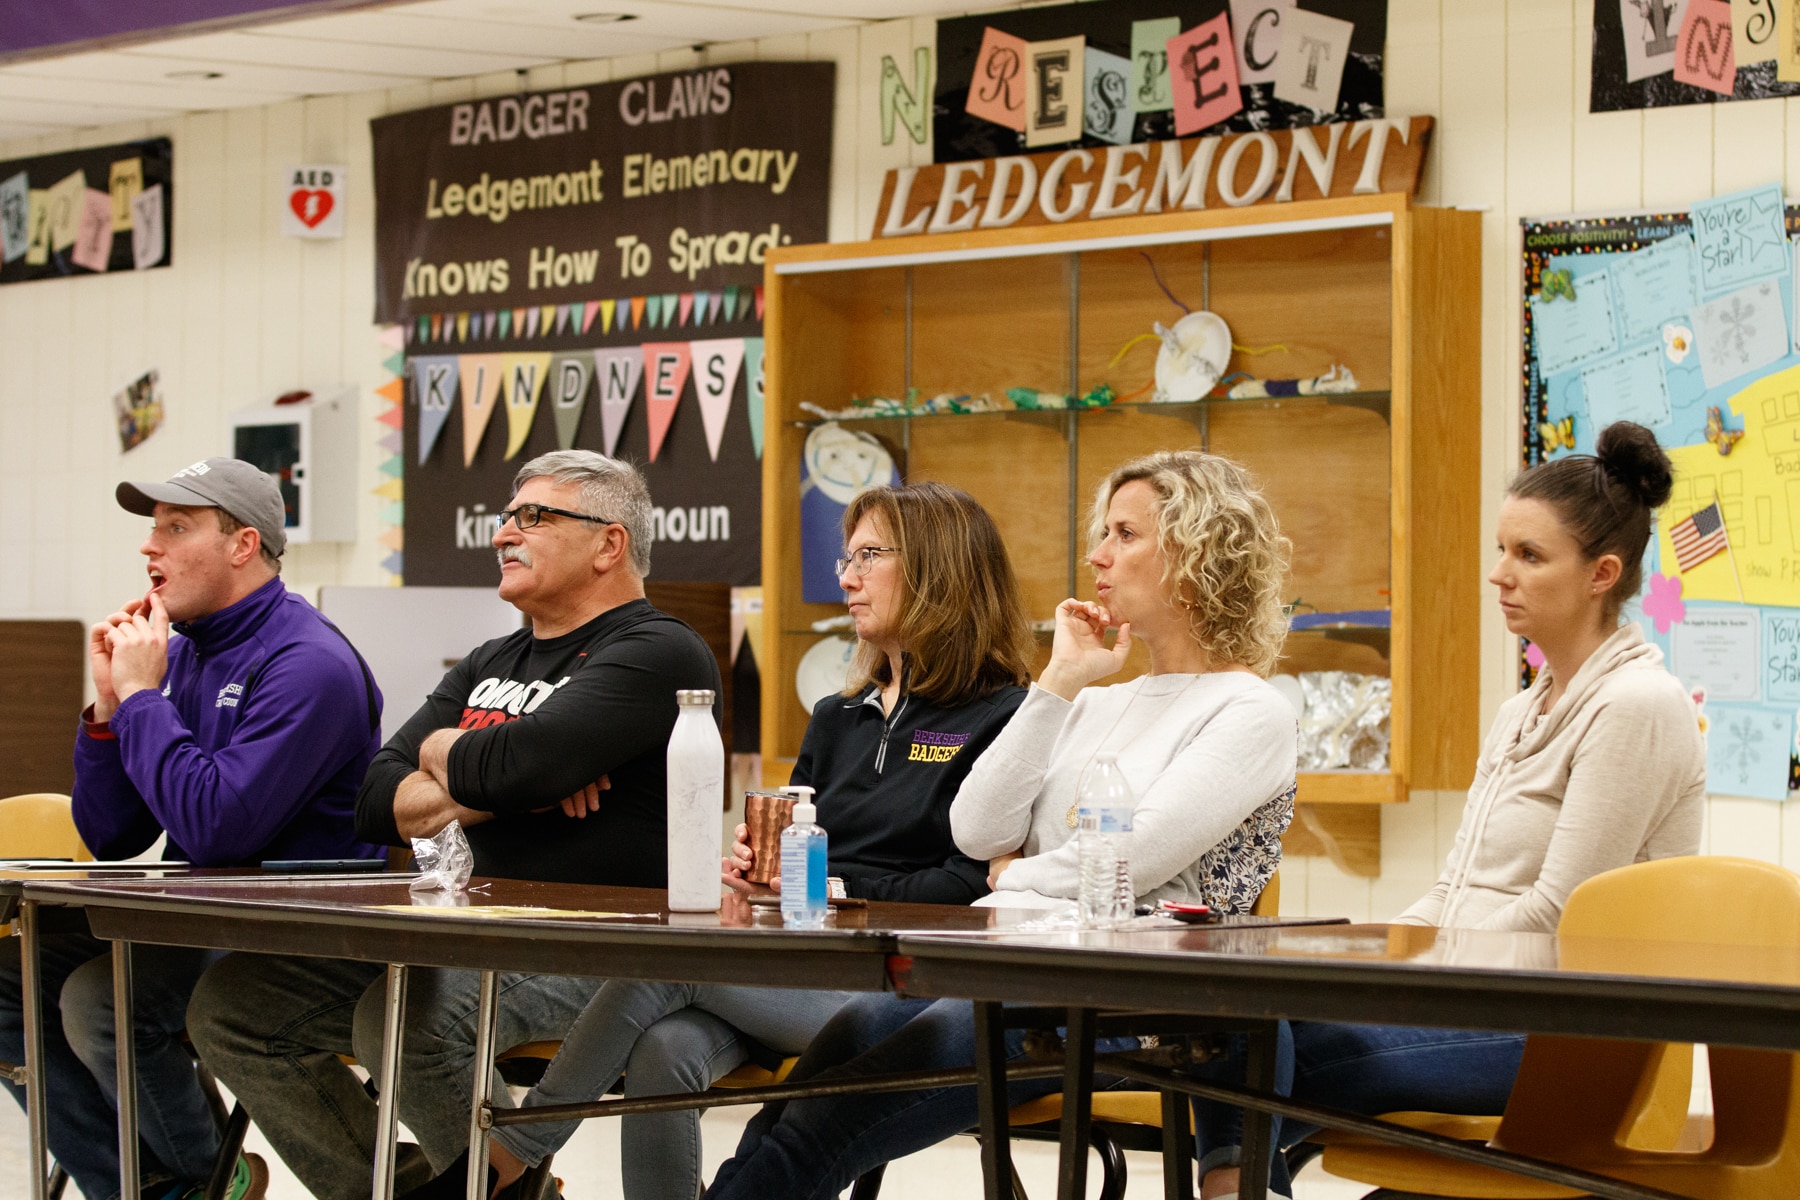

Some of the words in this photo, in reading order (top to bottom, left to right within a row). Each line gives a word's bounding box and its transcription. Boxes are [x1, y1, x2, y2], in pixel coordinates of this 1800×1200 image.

[880, 47, 931, 146] N
[978, 8, 1332, 136] RESPECT
[450, 90, 590, 145] BADGER
[619, 68, 731, 126] CLAWS
[293, 170, 335, 187] AED
[426, 160, 603, 223] Ledgemont
[881, 117, 1411, 237] LEDGEMONT
[528, 248, 599, 289] How
[615, 235, 652, 279] To
[1527, 232, 1567, 247] CHOOSE
[1571, 228, 1627, 244] POSITIVITY!
[1637, 225, 1670, 240] LEARN
[1702, 238, 1744, 273] Star!
